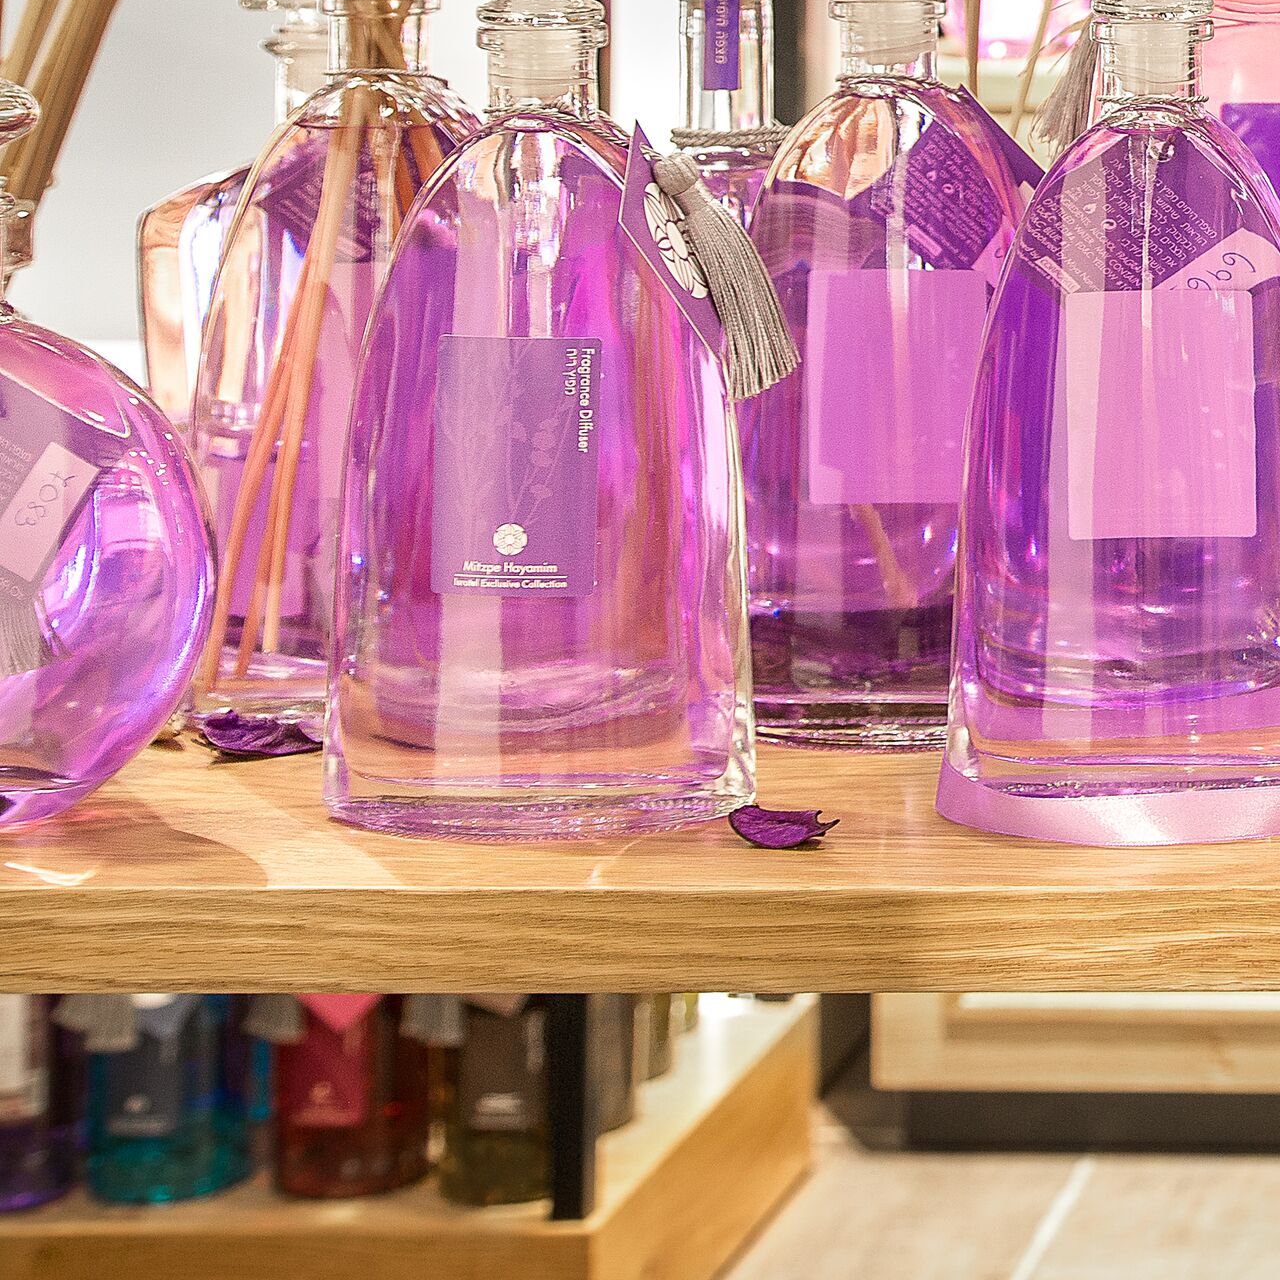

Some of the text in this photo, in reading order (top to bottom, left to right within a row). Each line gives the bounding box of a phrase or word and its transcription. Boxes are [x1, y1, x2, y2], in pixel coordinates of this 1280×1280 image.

[562, 348, 578, 396] ריח מפיץ
[577, 348, 596, 407] Fragrance
[463, 560, 558, 575] Mitzpe Hayamim
[481, 579, 520, 588] Exclusive
[520, 580, 568, 589] Collection
